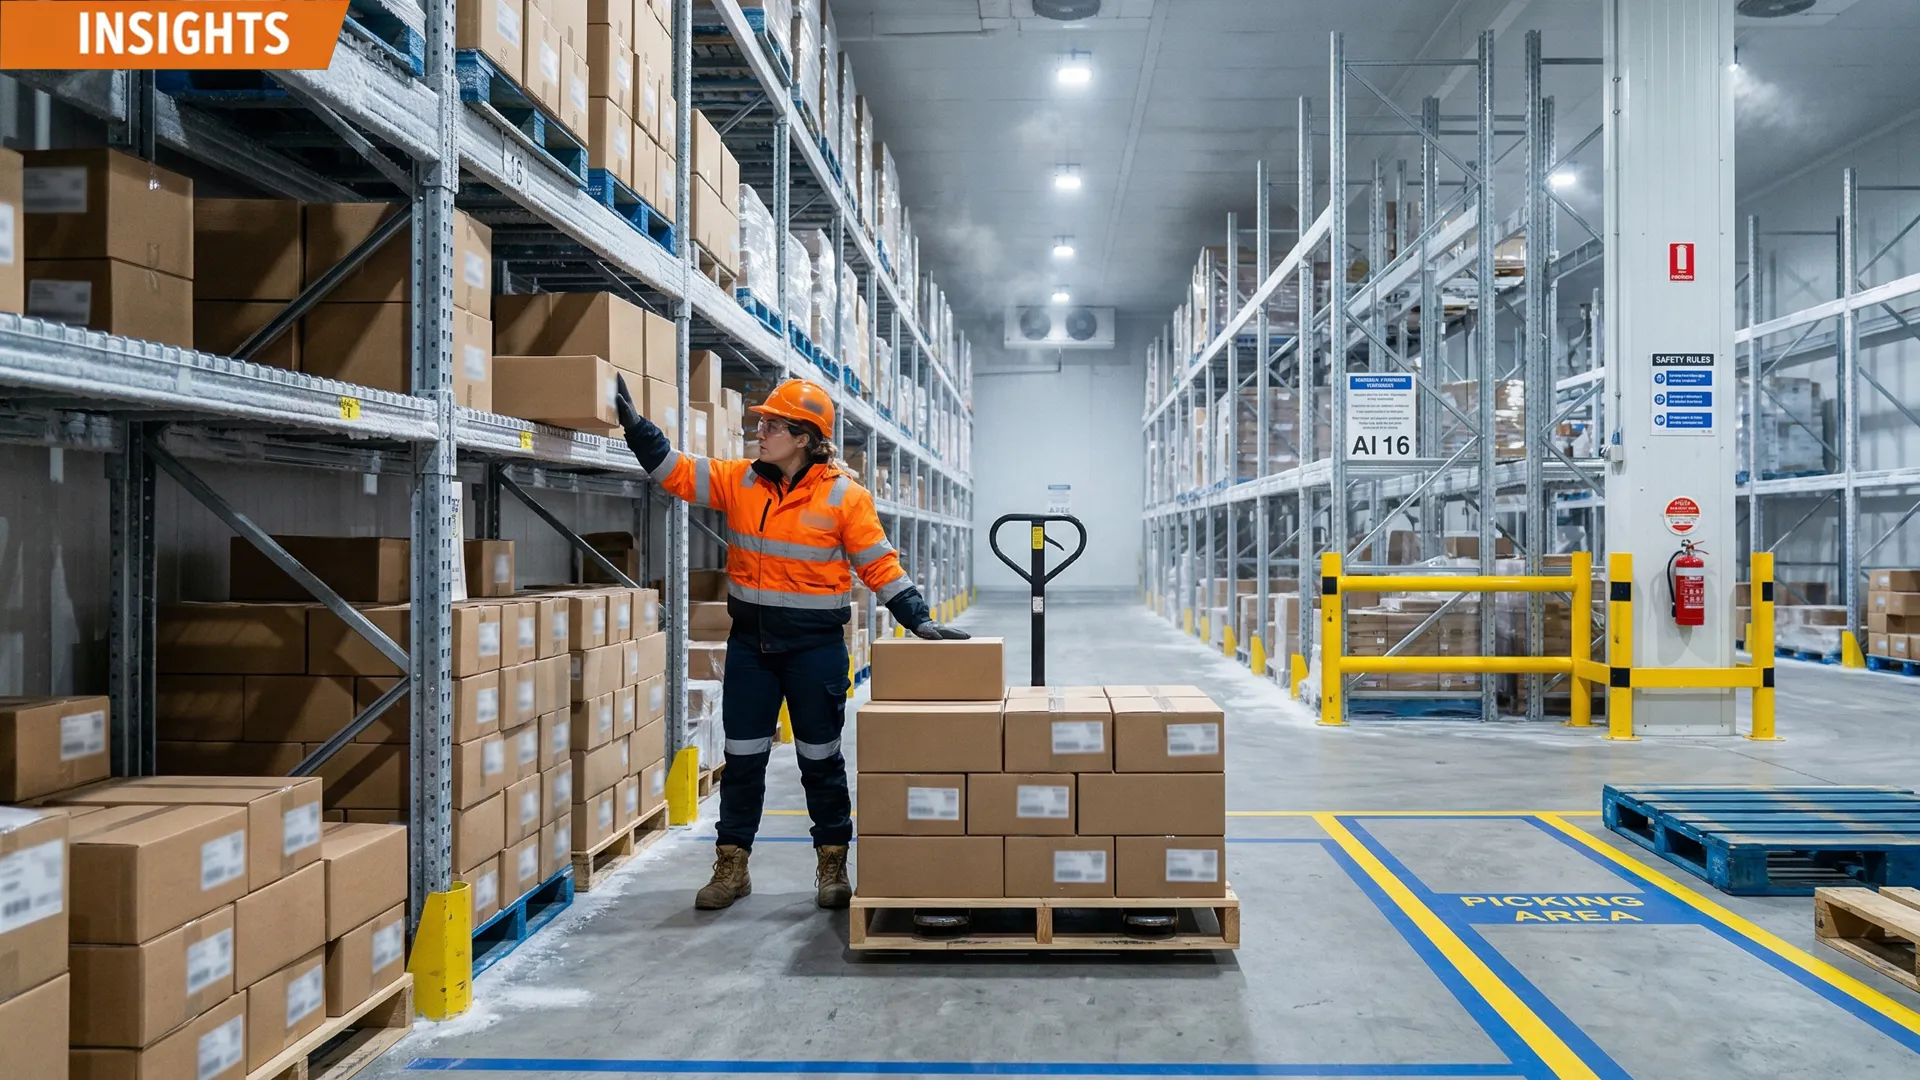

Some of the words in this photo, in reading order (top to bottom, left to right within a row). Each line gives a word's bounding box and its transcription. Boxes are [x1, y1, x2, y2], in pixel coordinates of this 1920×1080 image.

[1655, 355, 1685, 364] SAFETY
[1686, 355, 1711, 364] RULES
[1382, 435, 1410, 455] 16
[1459, 896, 1645, 907] PICKING
[1515, 910, 1644, 922] AREA
